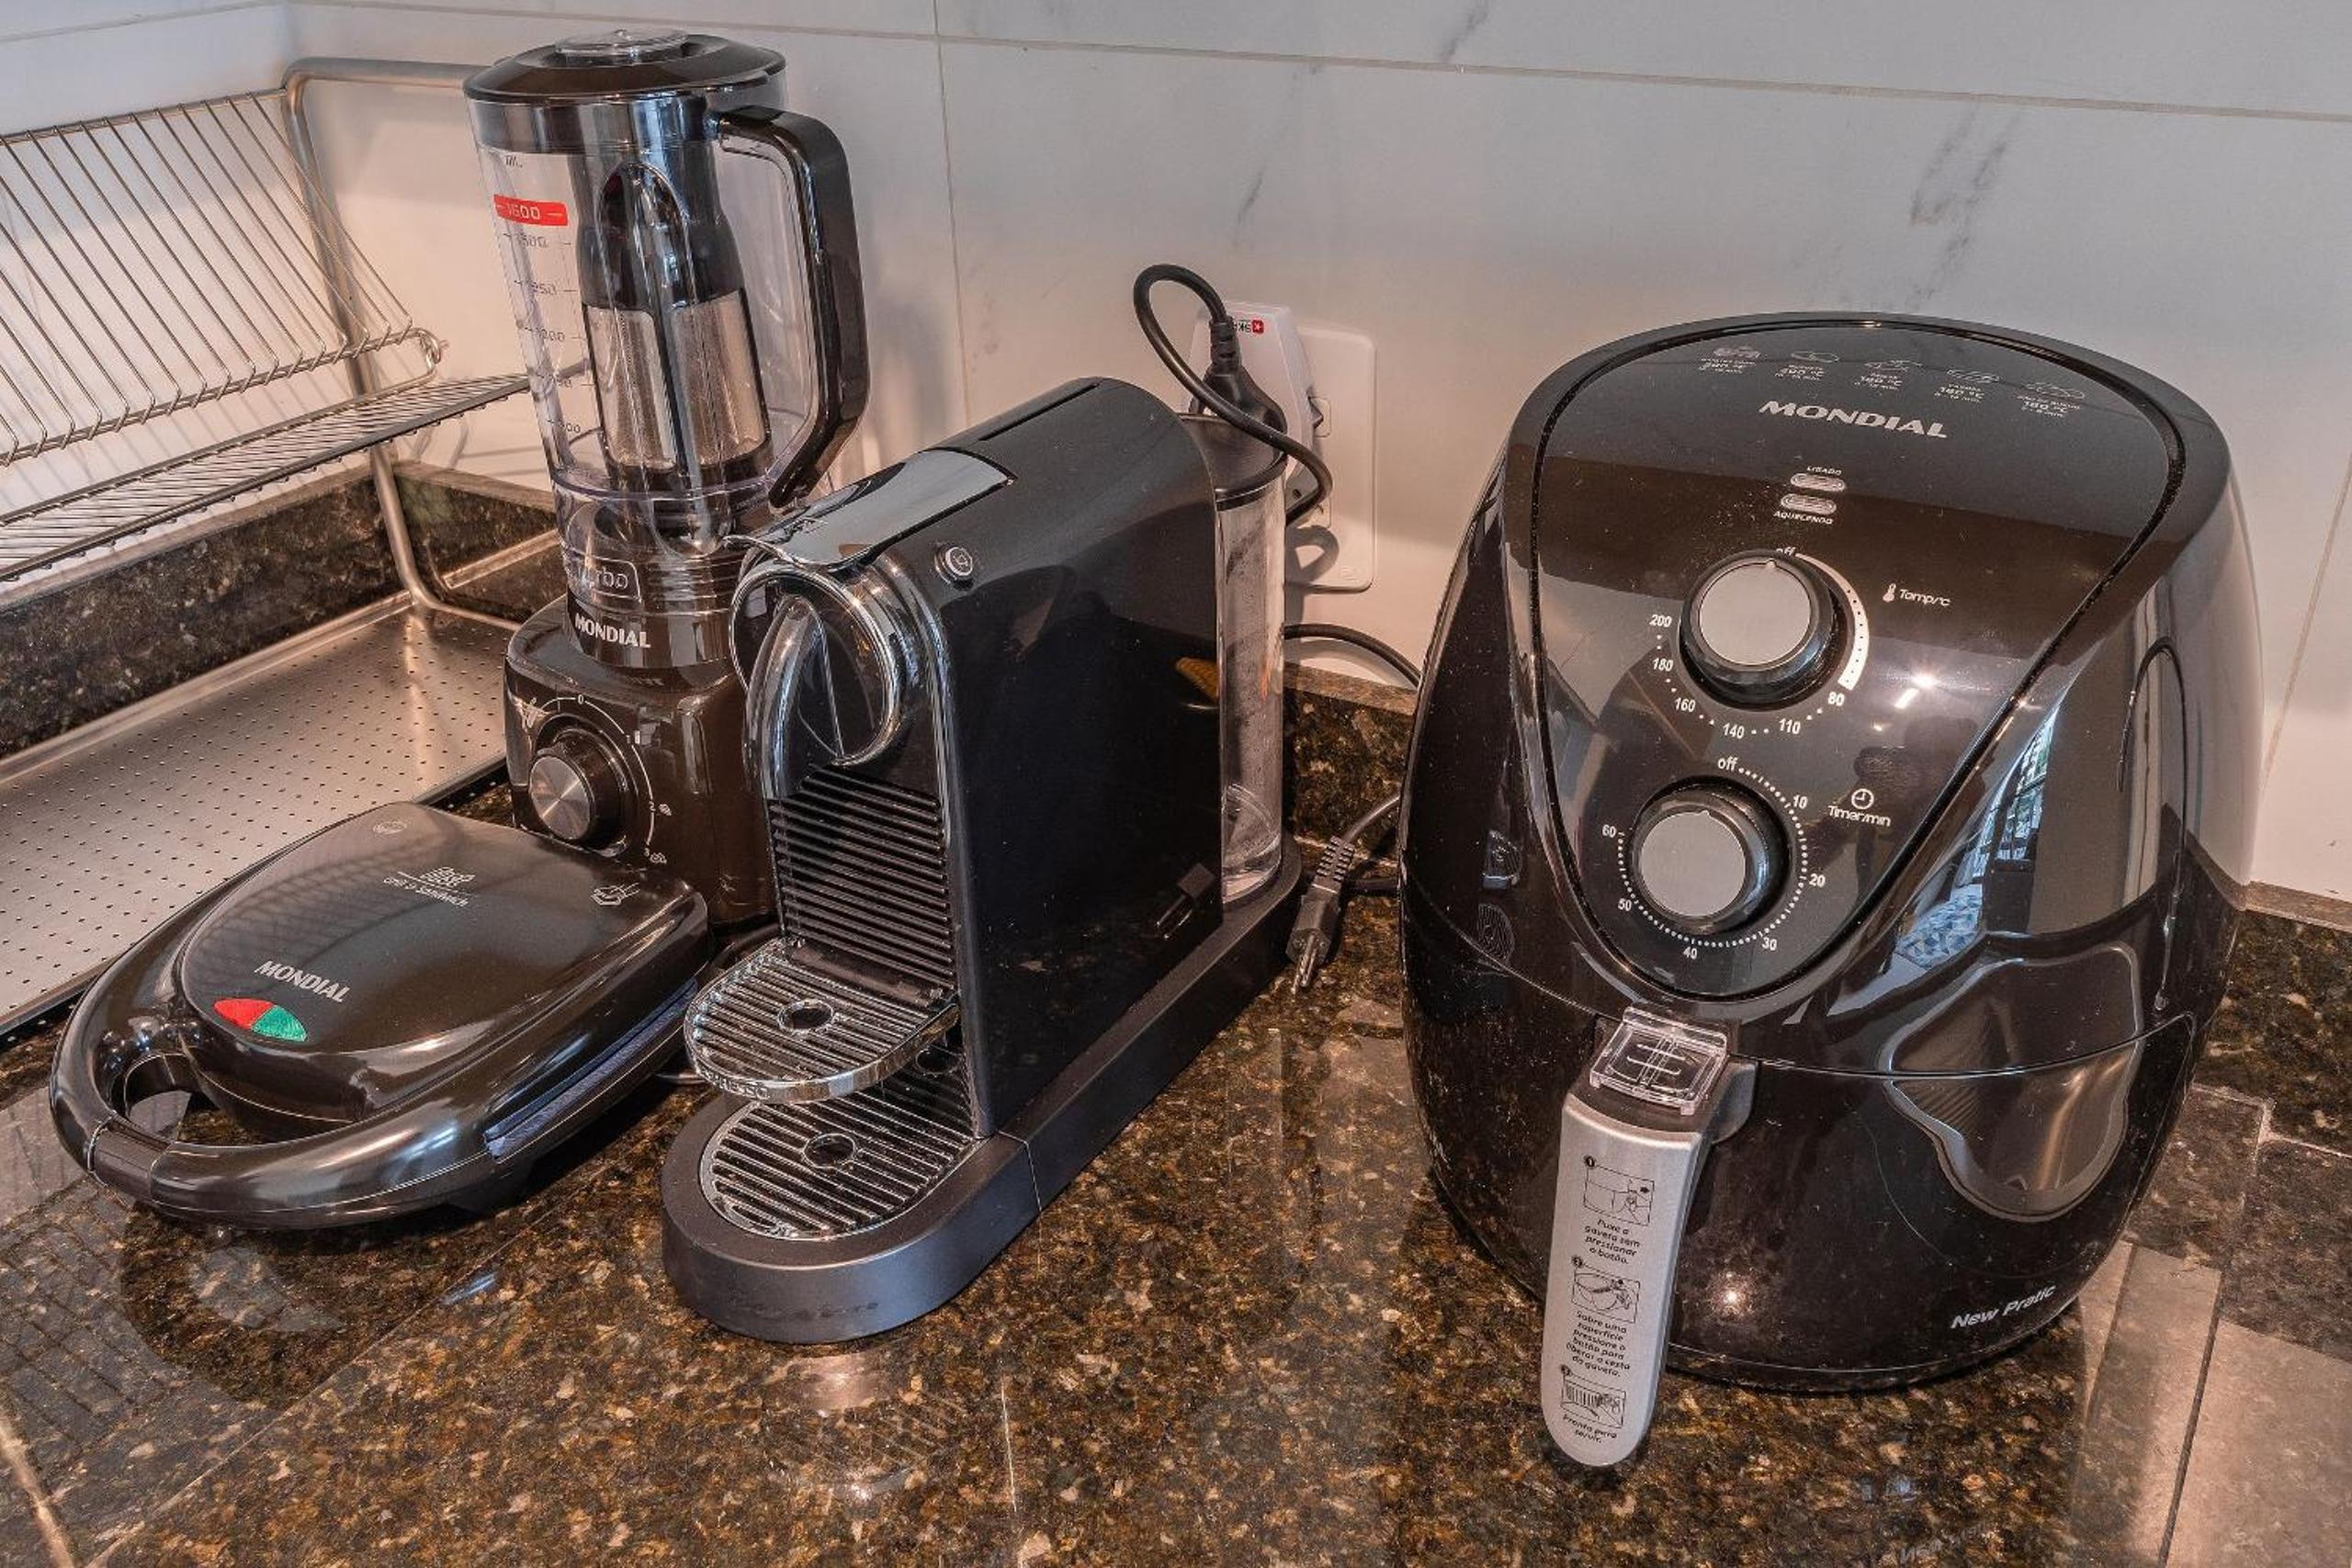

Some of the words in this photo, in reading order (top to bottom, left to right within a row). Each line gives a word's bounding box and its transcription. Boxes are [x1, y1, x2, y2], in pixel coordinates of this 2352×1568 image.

[1758, 400, 1949, 439] MONDIAL
[1649, 614, 1673, 628] 200
[574, 613, 651, 649] MONDIAL
[1653, 658, 1674, 671] 180
[1674, 696, 1696, 713] 160
[1827, 692, 1846, 707] 80
[1722, 724, 1745, 739] 140
[1779, 718, 1801, 735] 110
[1717, 756, 1737, 772] off
[1792, 795, 1809, 809] 10
[1601, 824, 1617, 839] 60
[1808, 873, 1826, 887] 20
[1618, 897, 1632, 912] 50
[1761, 937, 1779, 952] 30
[1682, 946, 1698, 960] 40
[254, 960, 351, 1003] MONDIAL
[1951, 1308, 1999, 1329] New
[2002, 1285, 2057, 1316] Pratic
